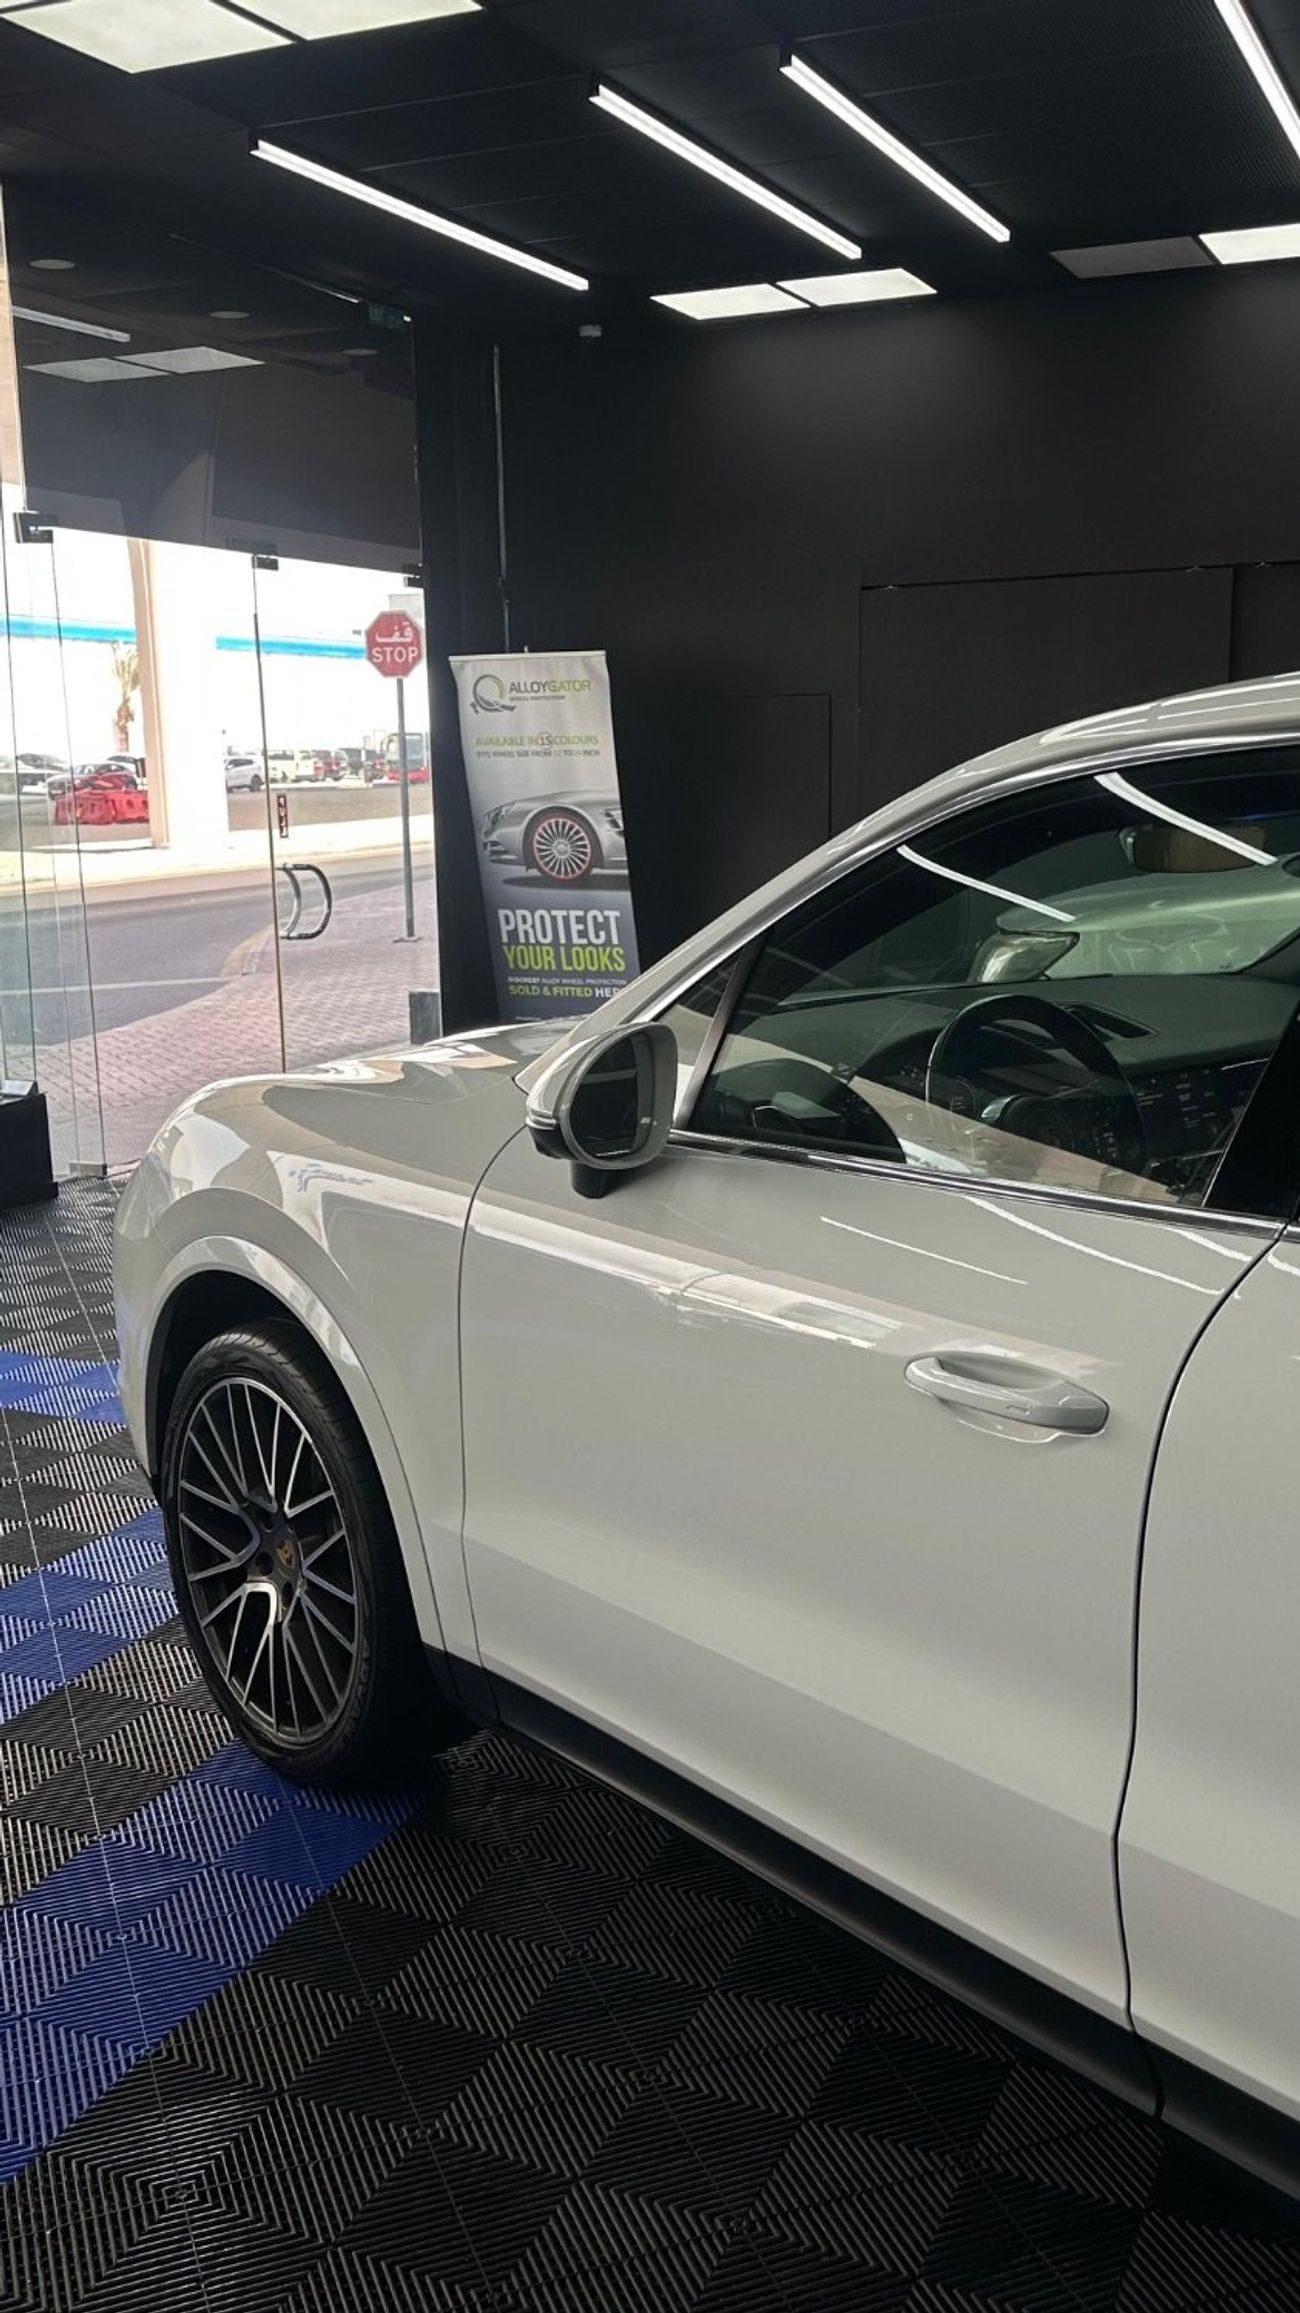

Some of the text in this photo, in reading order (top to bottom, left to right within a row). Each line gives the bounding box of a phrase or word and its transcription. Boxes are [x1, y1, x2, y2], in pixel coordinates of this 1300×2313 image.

[375, 621, 413, 642] قف
[372, 646, 418, 663] STOP
[509, 680, 591, 693] ALLOYGATOR
[476, 736, 525, 746] AVAILABLE
[528, 736, 538, 746] IN
[553, 735, 598, 745] COLOURS
[583, 749, 600, 757] INCH
[497, 909, 620, 945] PROTECT
[502, 945, 626, 972] YOUR LOOKS
[509, 985, 540, 996] SOLD
[542, 987, 552, 996] &
[553, 986, 592, 997] FITTED
